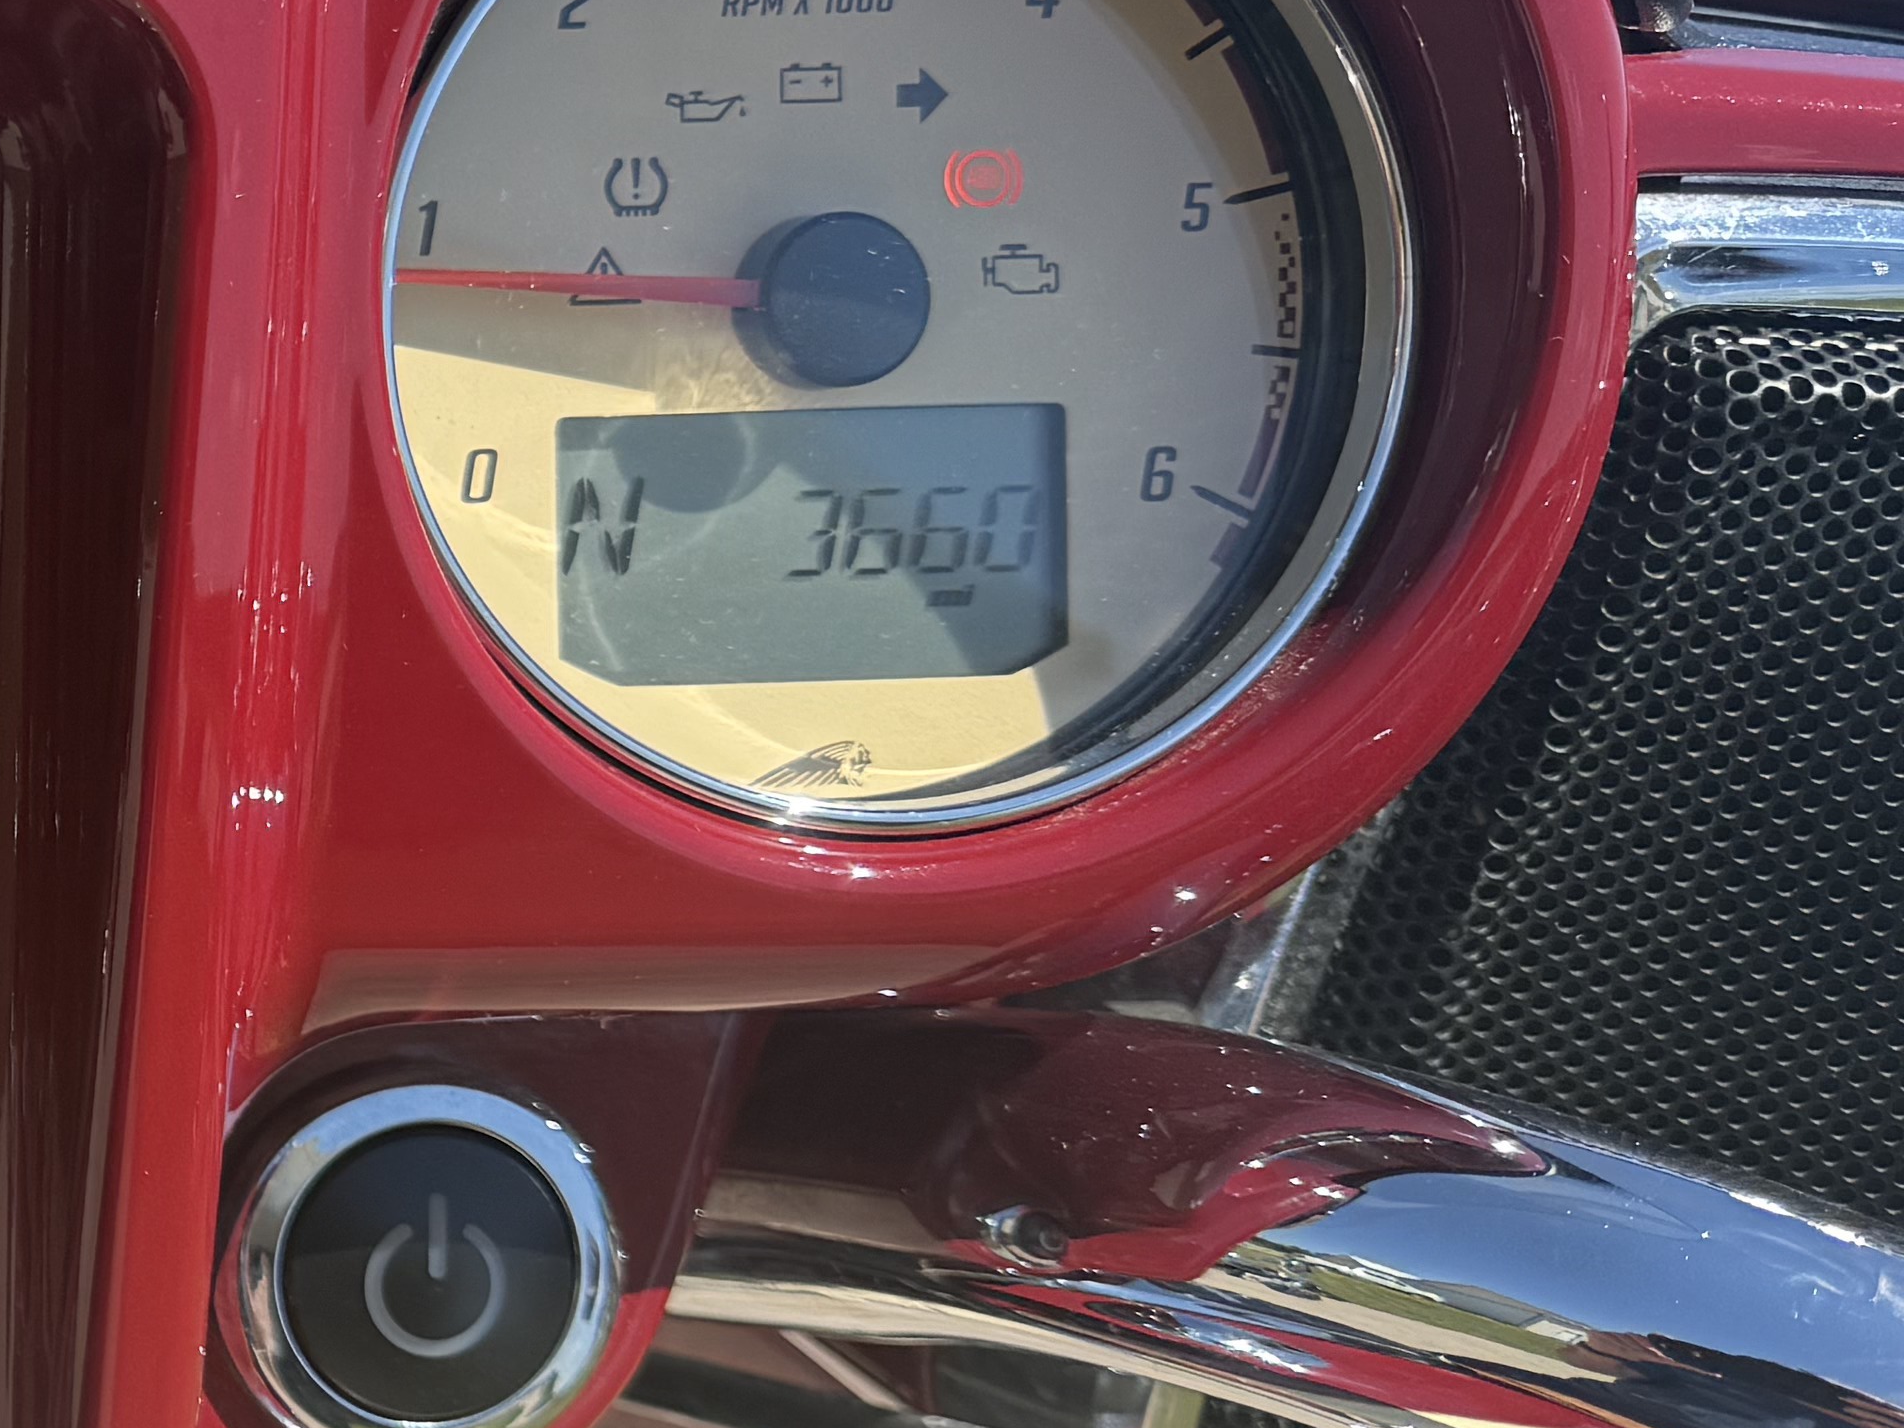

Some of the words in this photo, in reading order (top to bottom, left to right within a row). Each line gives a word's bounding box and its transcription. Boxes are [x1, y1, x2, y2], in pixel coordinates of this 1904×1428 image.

[418, 202, 440, 255] 1
[1181, 184, 1213, 232] 5
[461, 448, 498, 503] 0
[1140, 446, 1176, 501] 6
[563, 476, 645, 576] N
[785, 484, 1038, 579] 3660
